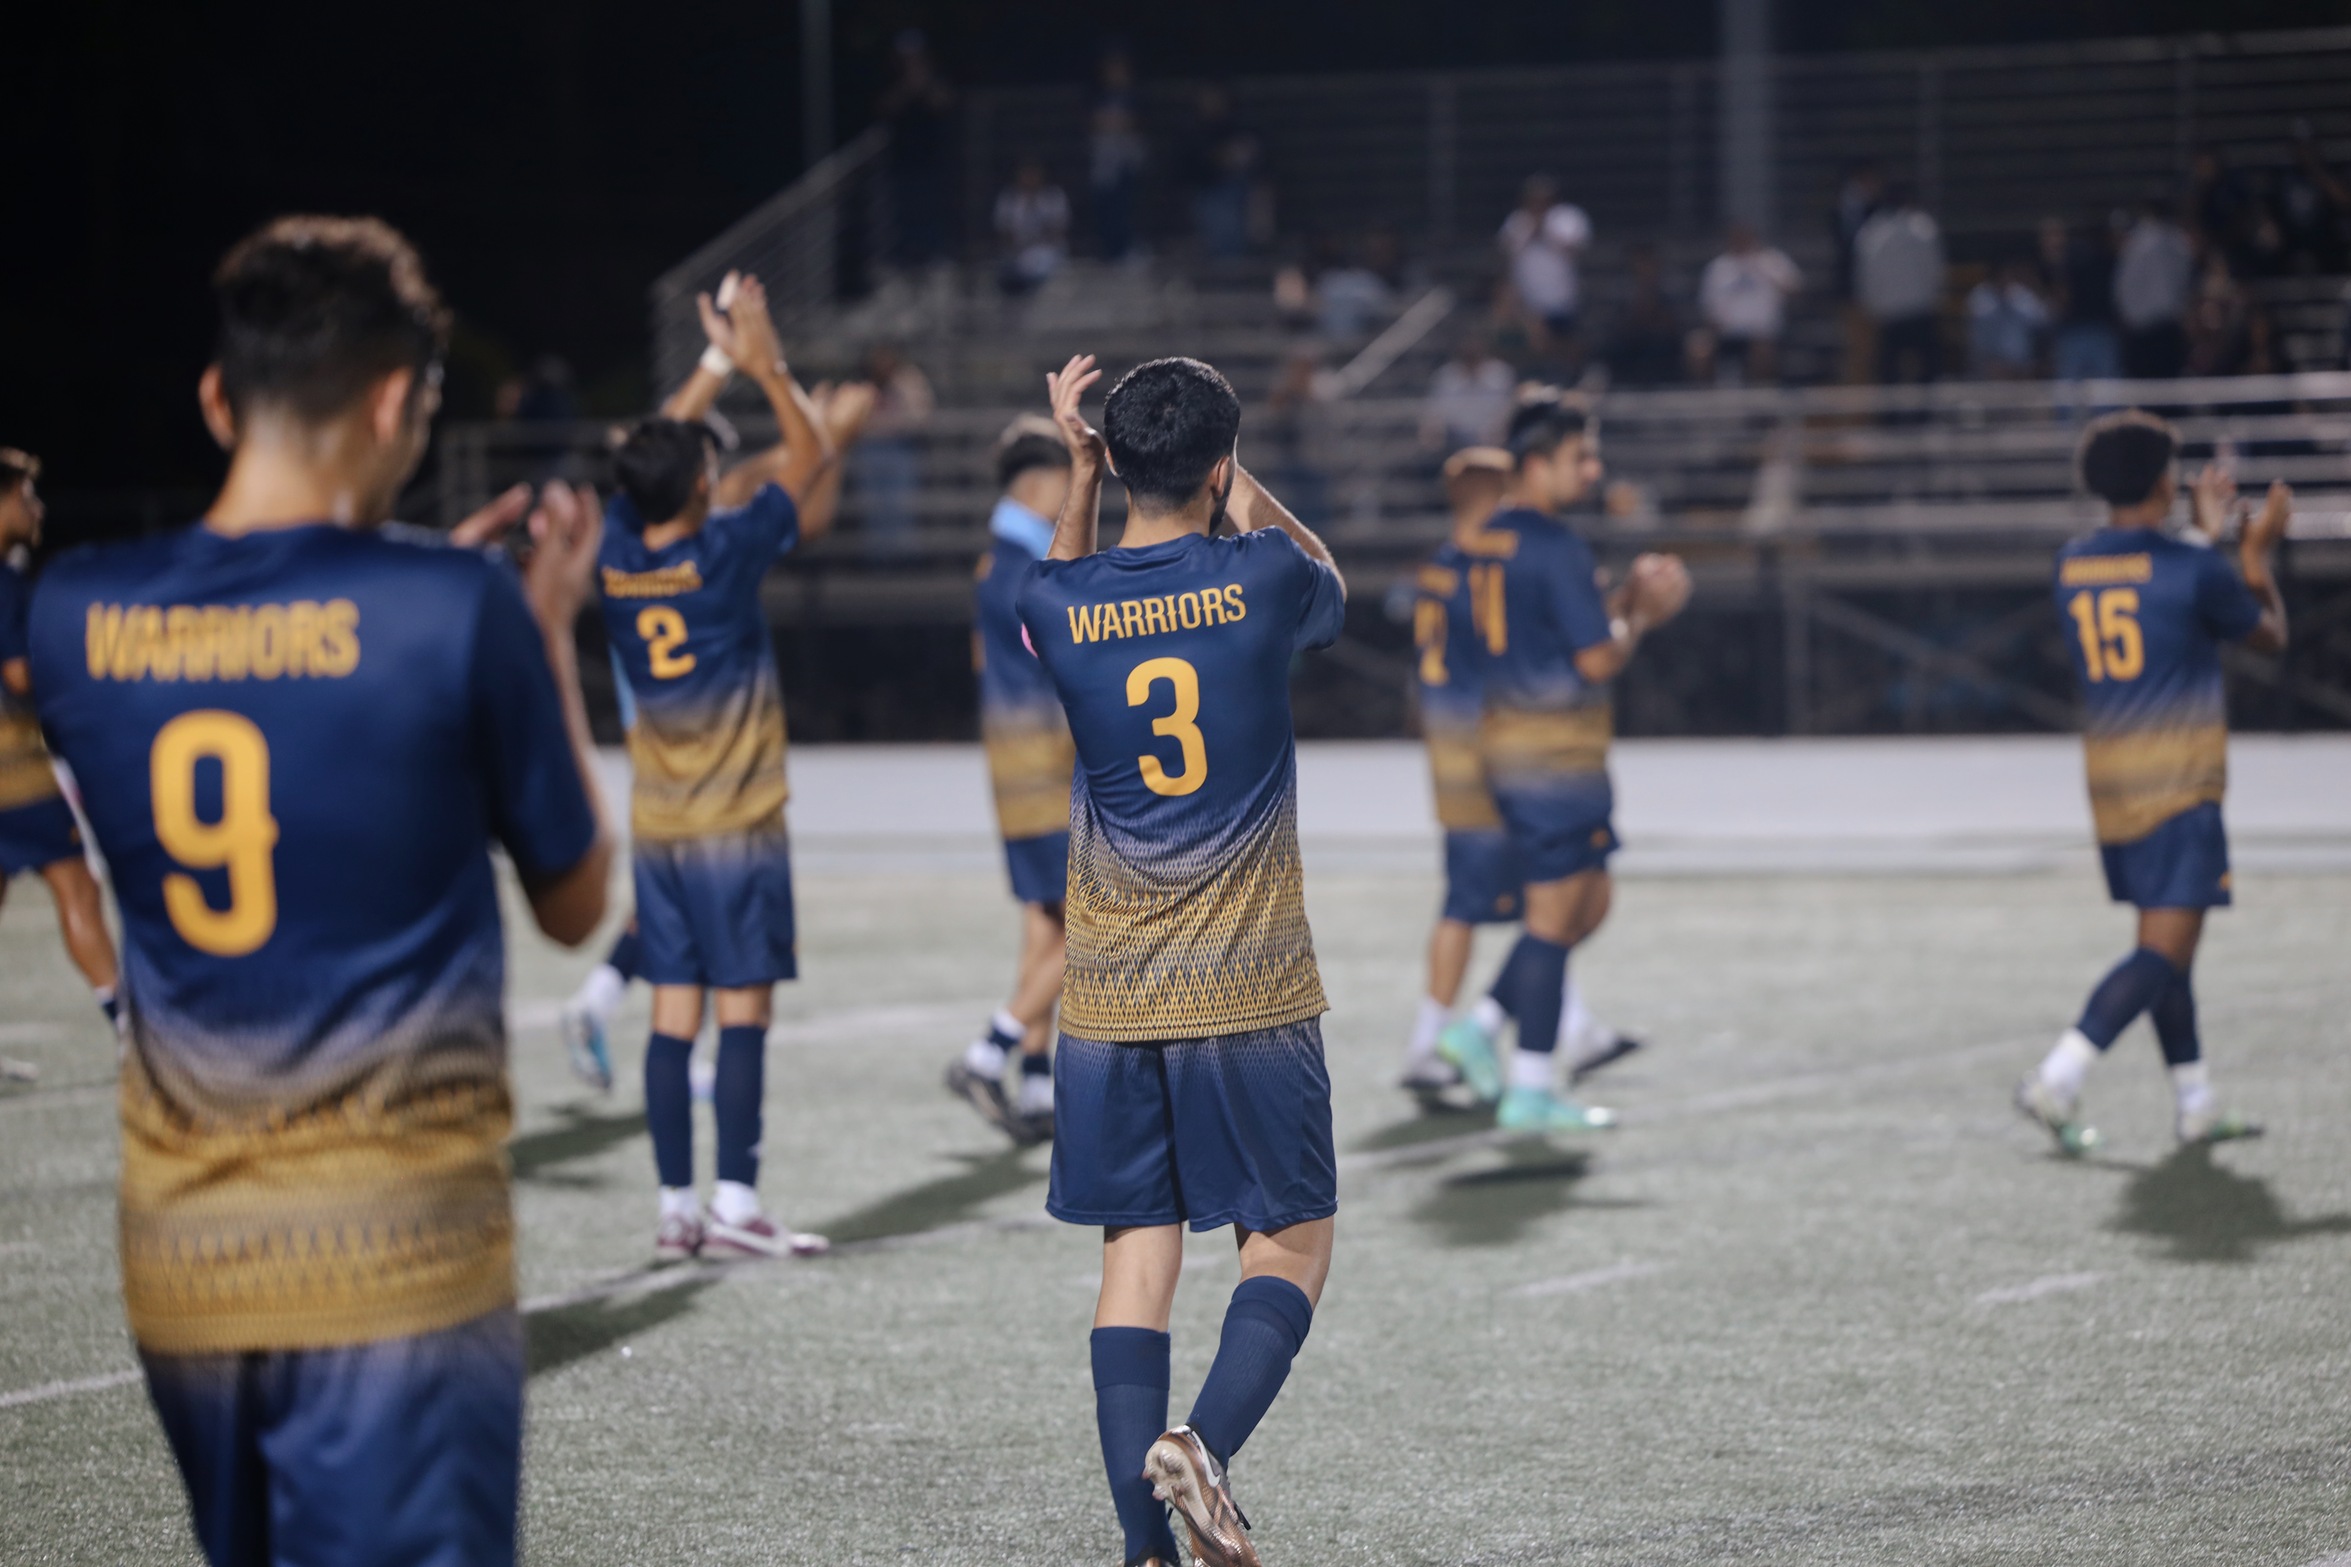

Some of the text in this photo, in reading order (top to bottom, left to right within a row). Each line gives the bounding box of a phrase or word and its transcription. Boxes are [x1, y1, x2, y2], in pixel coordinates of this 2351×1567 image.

[87, 599, 360, 681] WARRIORS
[635, 606, 697, 679] 2
[1067, 583, 1247, 644] WARRIORS
[2068, 588, 2145, 682] 15
[1126, 657, 1208, 796] 3
[151, 709, 279, 956] 9
